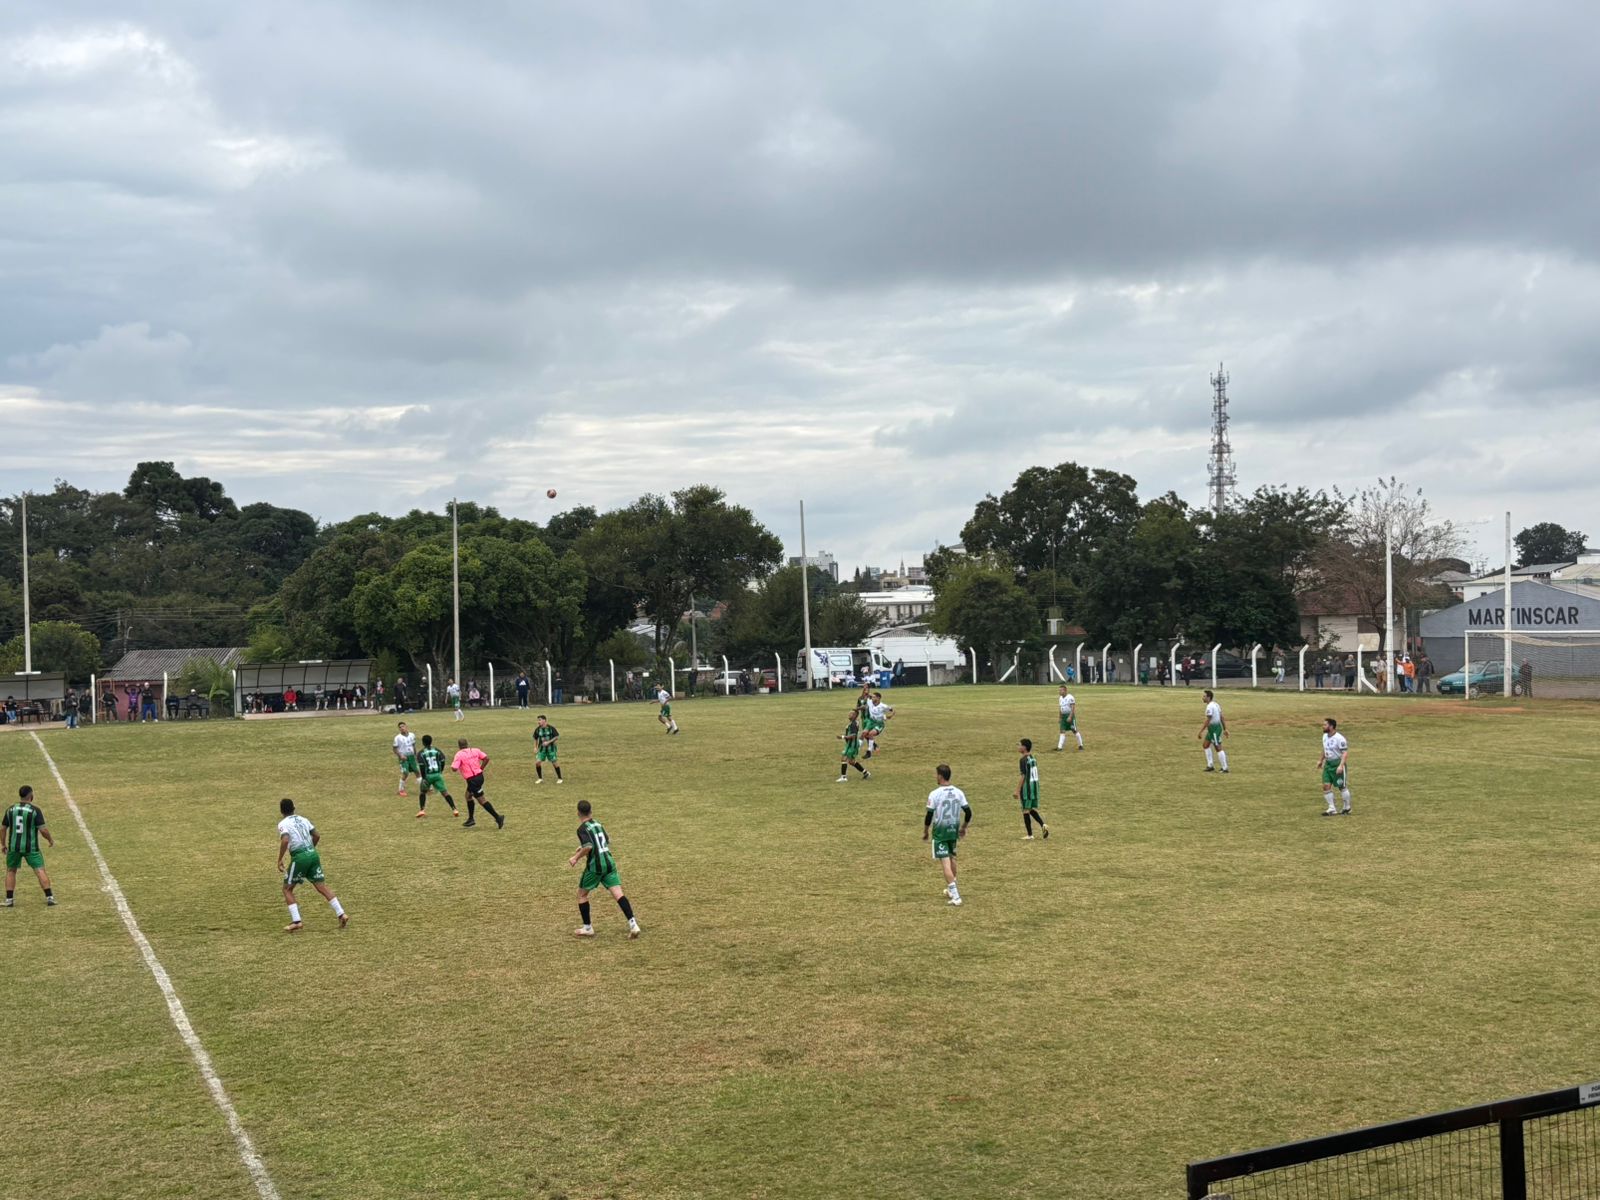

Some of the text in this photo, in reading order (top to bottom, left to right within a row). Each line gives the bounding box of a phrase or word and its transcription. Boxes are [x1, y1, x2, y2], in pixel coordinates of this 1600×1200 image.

[942, 799, 961, 820] 20
[15, 815, 24, 833] 5
[595, 831, 609, 852] 12
